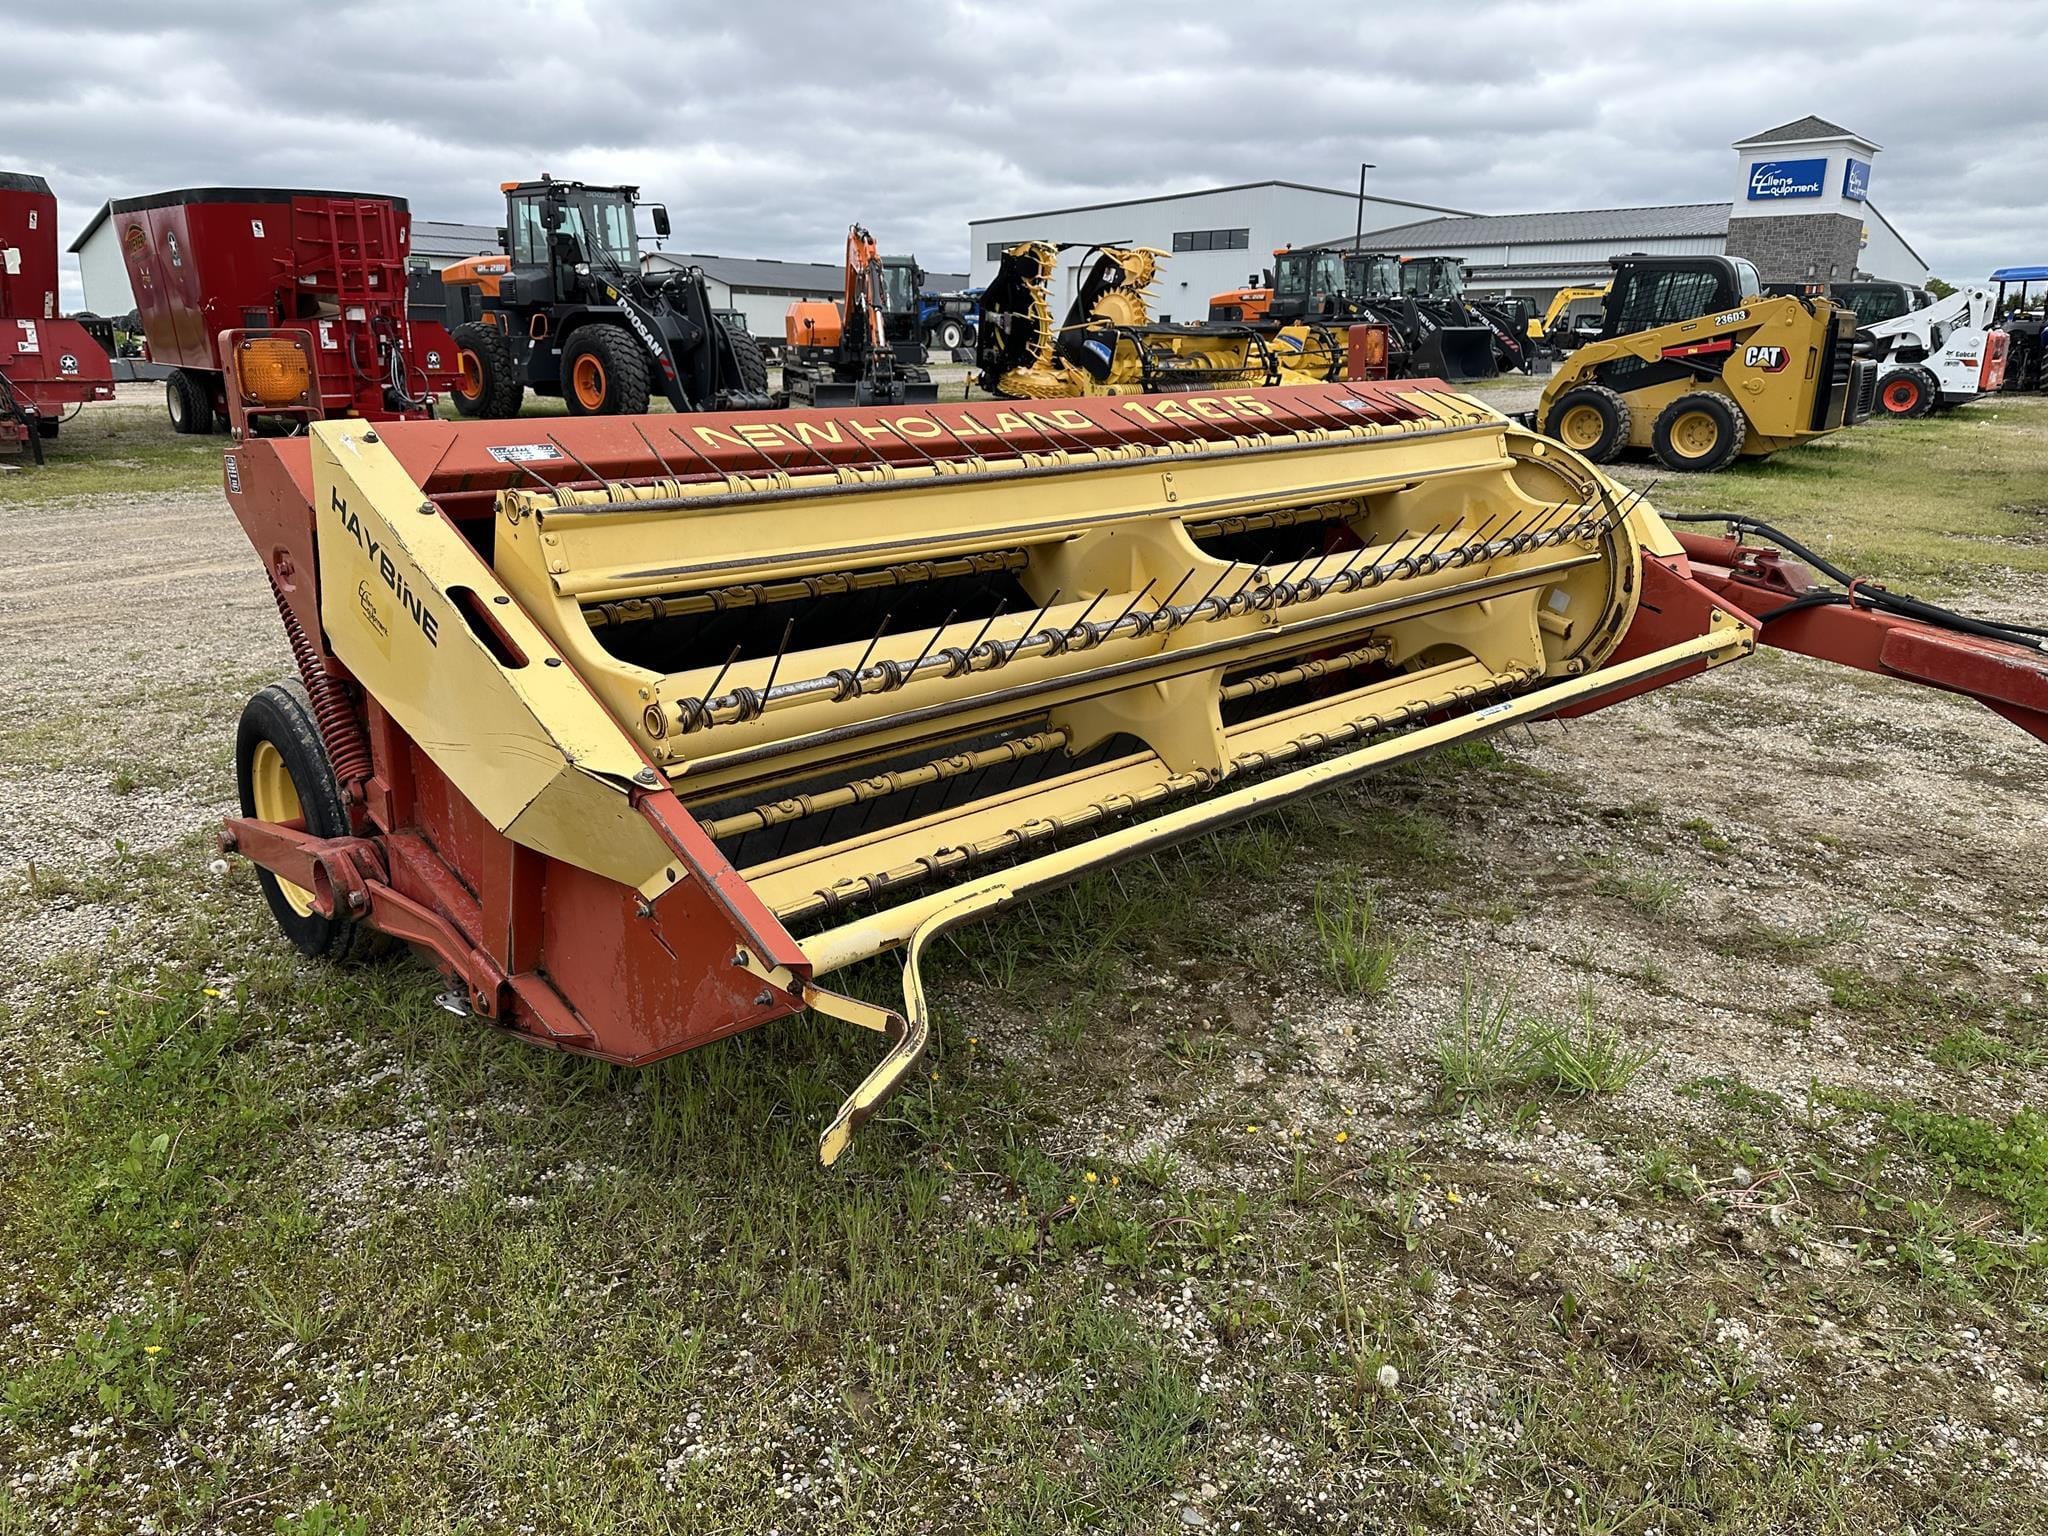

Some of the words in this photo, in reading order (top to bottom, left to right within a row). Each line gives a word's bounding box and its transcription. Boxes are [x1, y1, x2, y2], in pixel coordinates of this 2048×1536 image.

[1752, 164, 1792, 186] Ellens
[1756, 171, 1819, 196] Equipment
[616, 297, 664, 357] DOOSAN
[1714, 310, 1746, 326] 236D3
[1746, 346, 1781, 367] CAT
[1122, 395, 1273, 424] 1465
[692, 418, 844, 449] NEW
[848, 409, 1095, 441] HOLLAND
[331, 485, 439, 648] HAYBINE
